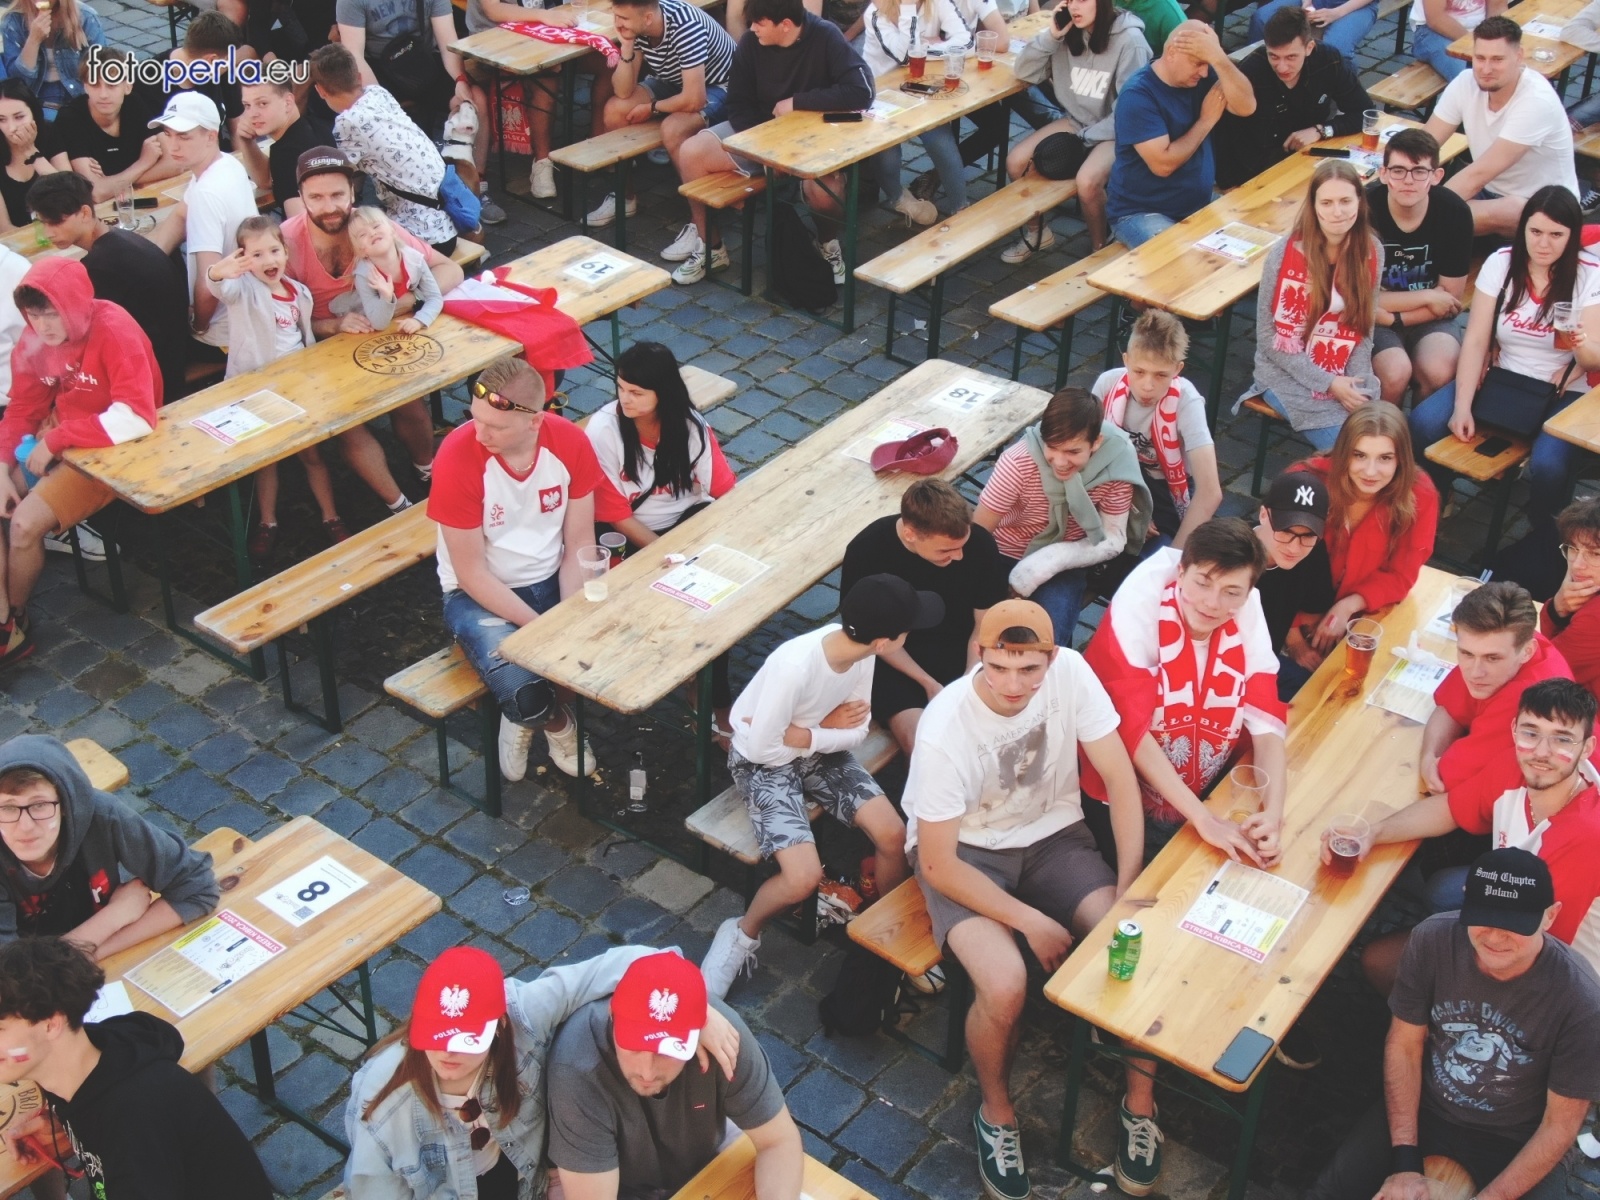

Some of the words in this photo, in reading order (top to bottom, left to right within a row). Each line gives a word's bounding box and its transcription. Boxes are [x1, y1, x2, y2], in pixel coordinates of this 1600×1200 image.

[1070, 66, 1111, 100] NIKE
[1475, 866, 1499, 883] South
[1500, 872, 1537, 888] Chapter
[297, 880, 331, 903] 8
[1484, 884, 1519, 899] Poland
[1184, 923, 1213, 940] STREFA
[1213, 932, 1242, 951] KIBICA
[1241, 945, 1263, 960] 2021
[433, 1027, 461, 1040] POLSKA
[644, 1031, 670, 1042] POLSKA
